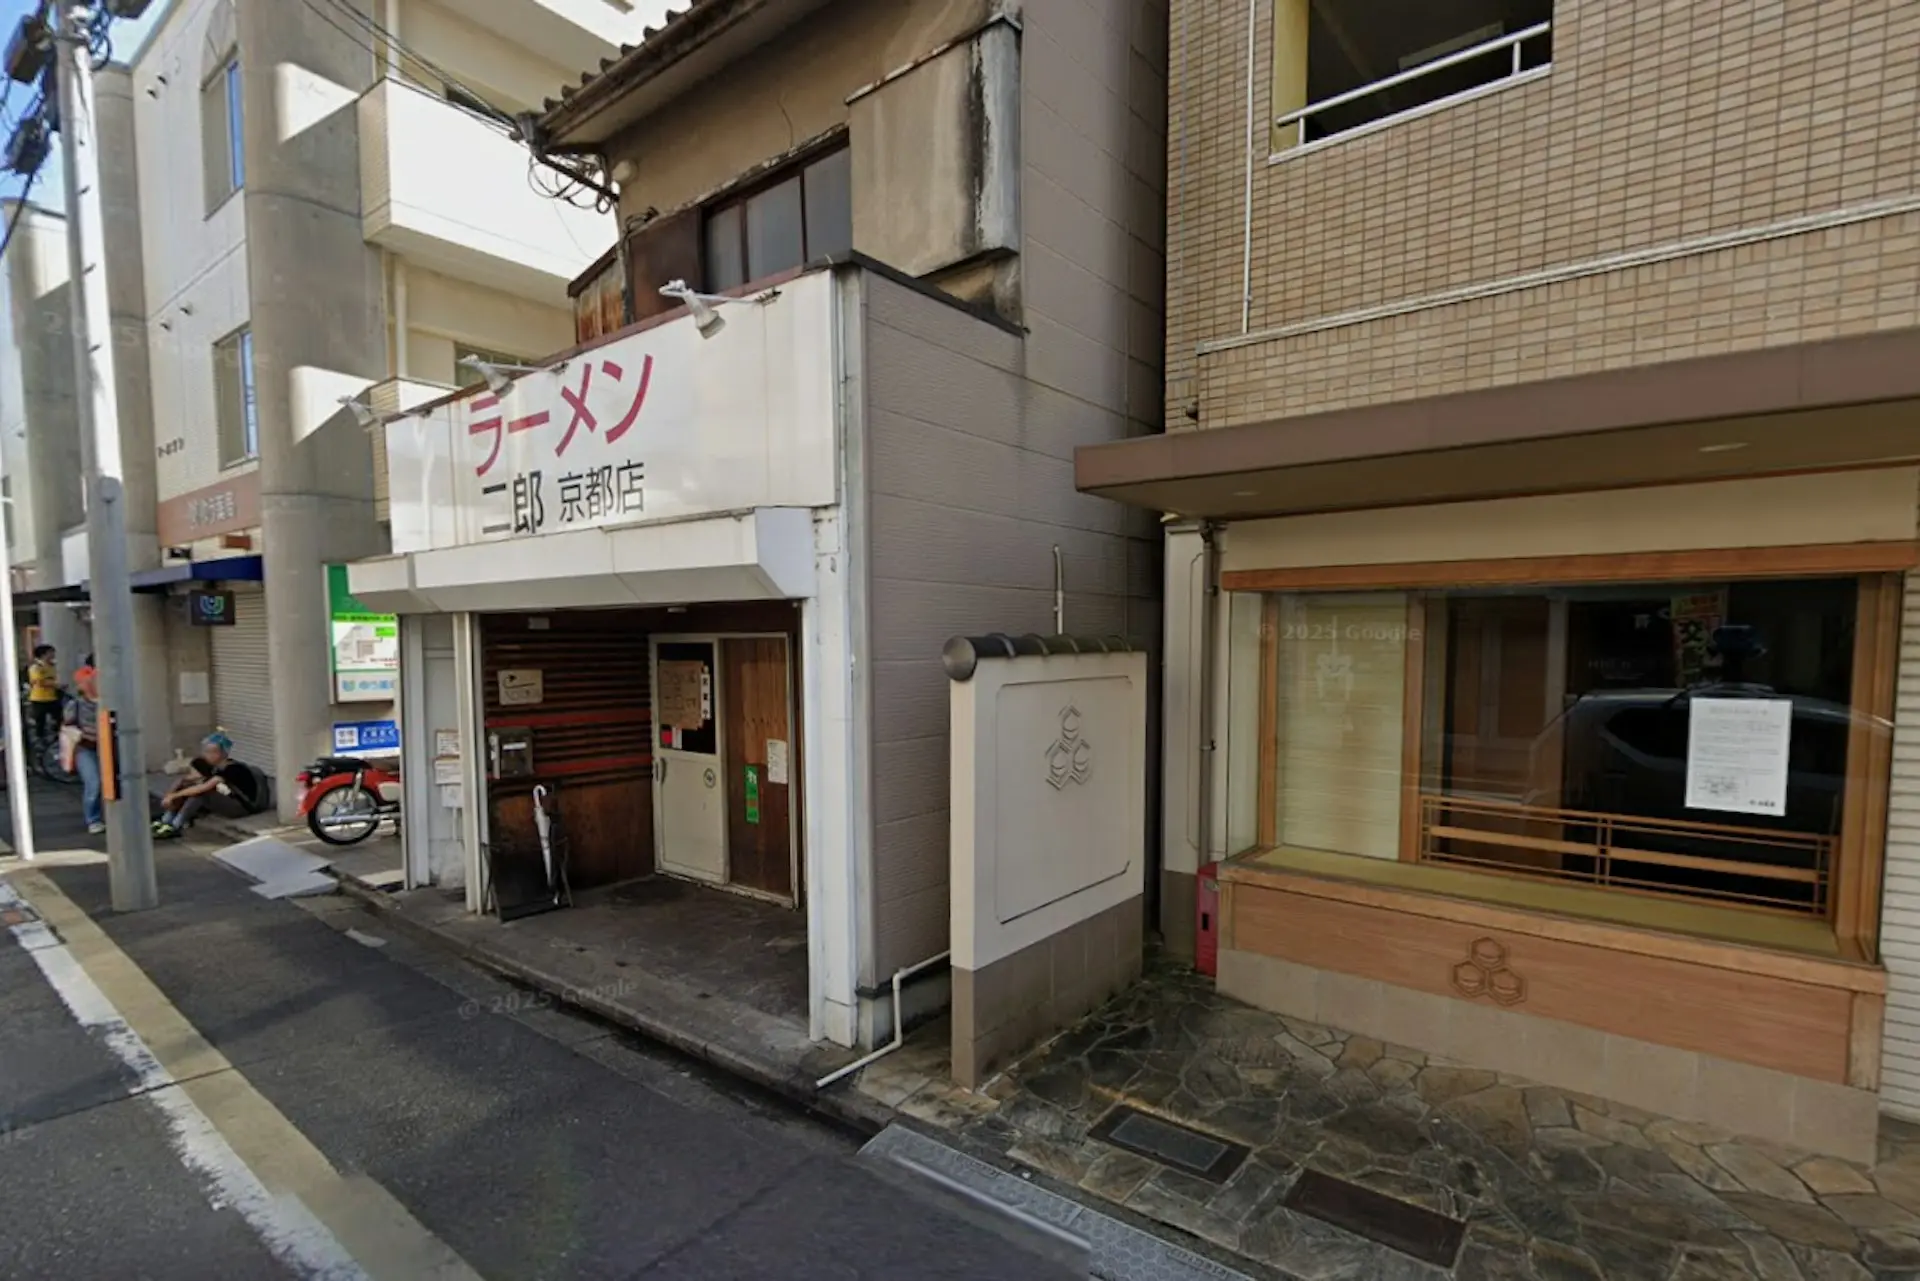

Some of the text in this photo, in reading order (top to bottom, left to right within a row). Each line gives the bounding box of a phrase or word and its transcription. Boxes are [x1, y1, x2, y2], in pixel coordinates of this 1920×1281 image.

[467, 353, 653, 477] ラーメン
[481, 459, 645, 535] 二郎 京都店
